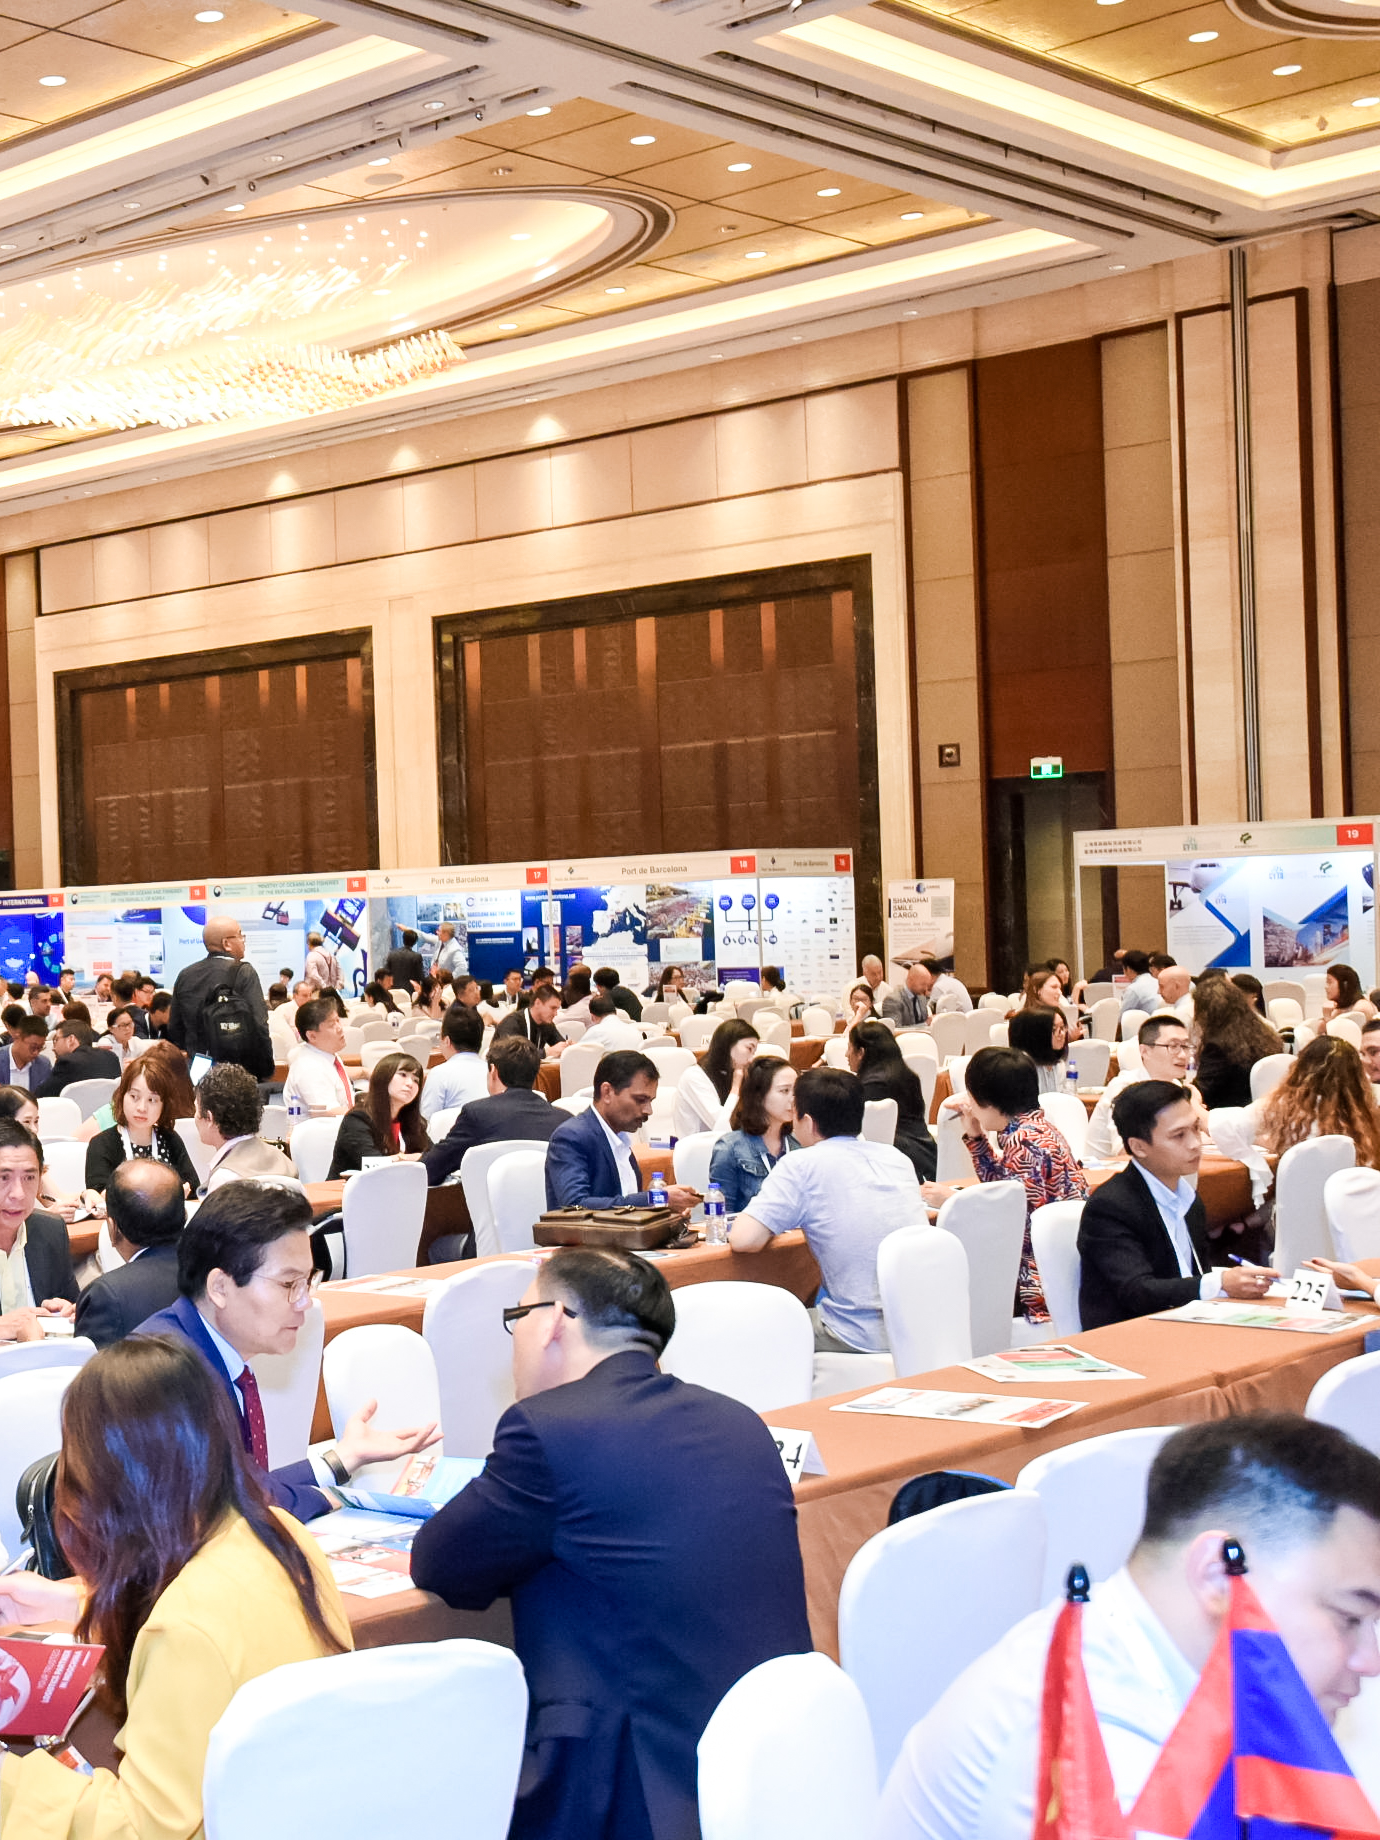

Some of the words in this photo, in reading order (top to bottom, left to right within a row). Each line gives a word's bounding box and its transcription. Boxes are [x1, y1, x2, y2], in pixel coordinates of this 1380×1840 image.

[1345, 829, 1359, 839] 19
[621, 867, 636, 875] Port
[639, 866, 648, 874] de
[649, 865, 688, 874] Barcelona
[431, 877, 444, 885] Port
[445, 876, 454, 885] de
[456, 875, 489, 884] Barcelona
[533, 871, 541, 880] 17
[2, 898, 44, 907] INTERNATIONAL
[892, 911, 918, 919] CARGO
[467, 919, 482, 928] CCIC
[1289, 1279, 1327, 1304] 225
